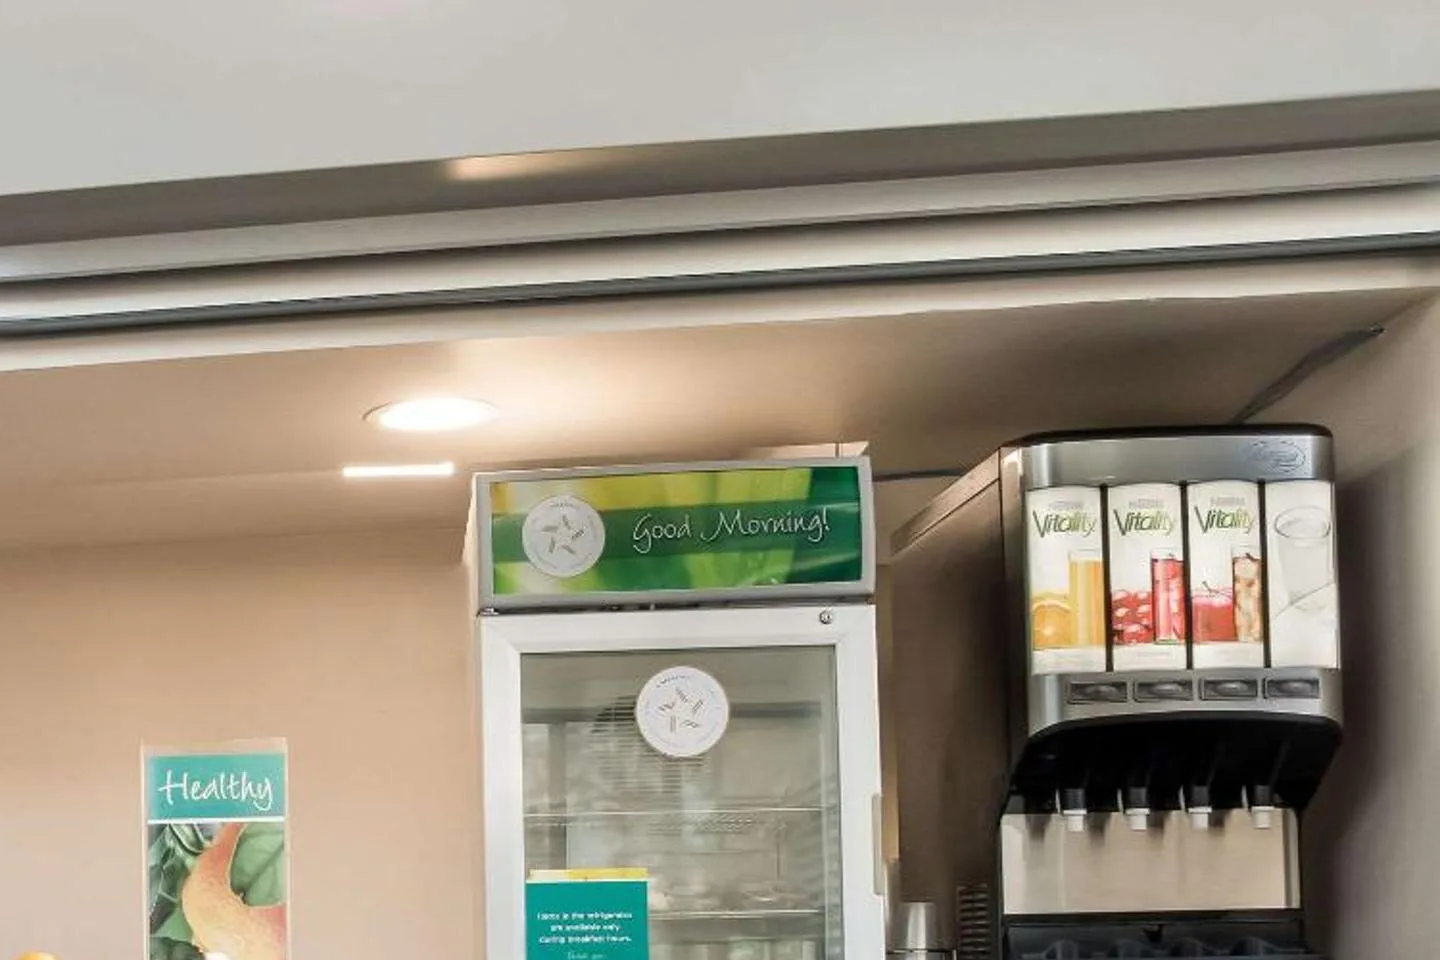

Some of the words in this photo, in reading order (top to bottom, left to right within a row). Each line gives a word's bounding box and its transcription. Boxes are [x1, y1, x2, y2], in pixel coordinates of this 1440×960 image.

[632, 511, 692, 554] Good
[699, 506, 831, 543] Morning!
[1032, 509, 1097, 539] Vitality
[1112, 508, 1178, 537] Vitality
[1194, 505, 1255, 534] Vitality
[157, 768, 273, 812] Healthy
